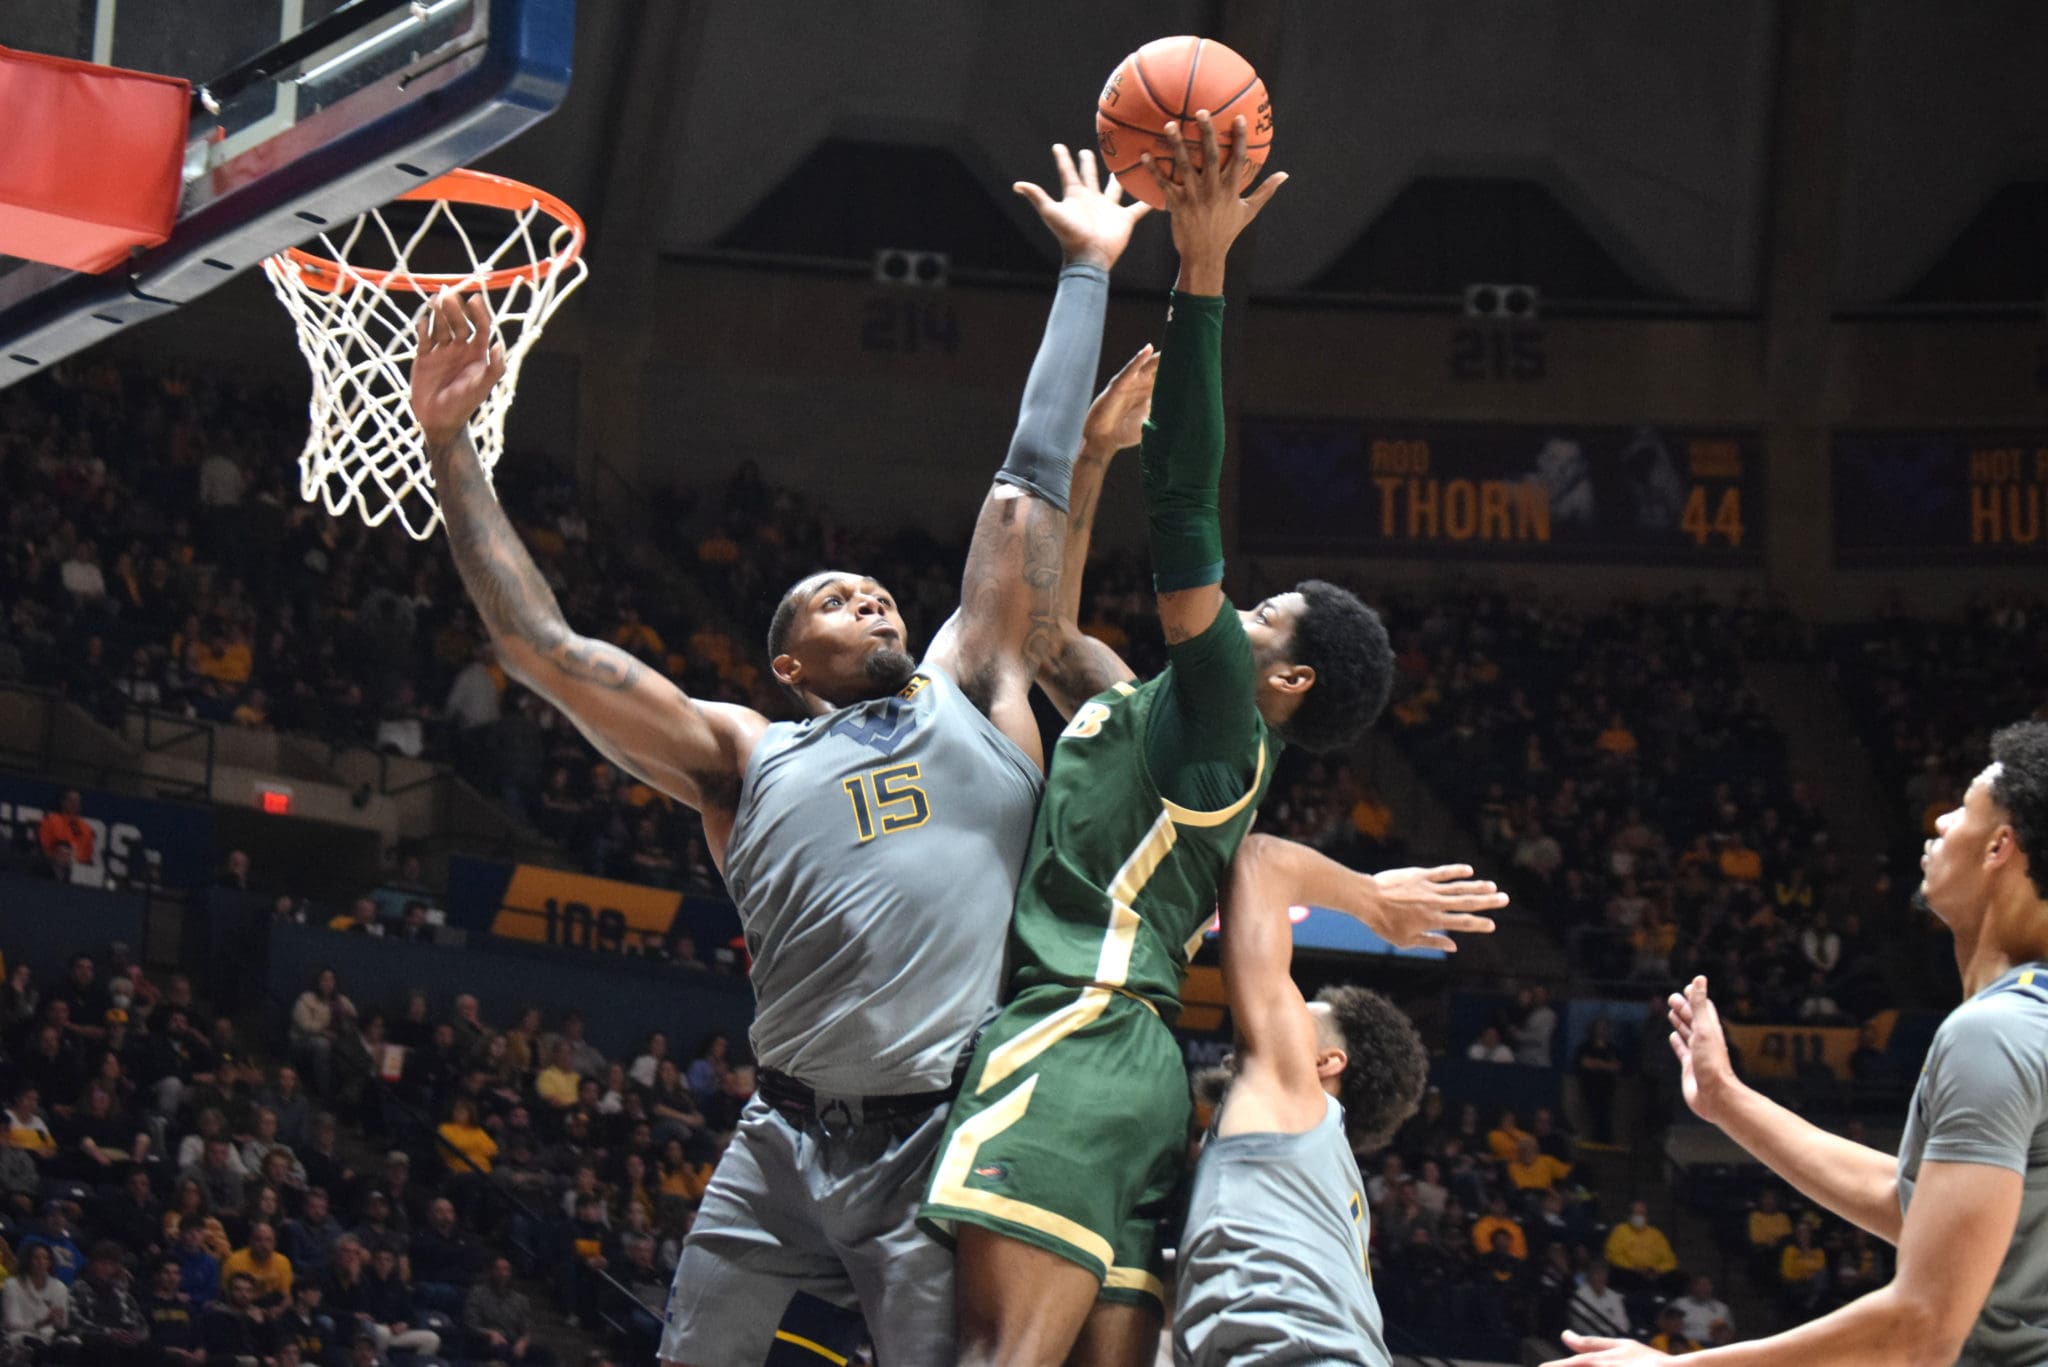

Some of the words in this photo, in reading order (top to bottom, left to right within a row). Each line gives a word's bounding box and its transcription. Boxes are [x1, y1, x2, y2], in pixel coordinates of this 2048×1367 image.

[1454, 329, 1543, 380] 215
[1373, 477, 1550, 541] THORN
[1681, 484, 1744, 545] 44
[1970, 483, 2048, 544] HU
[842, 762, 931, 842] 15
